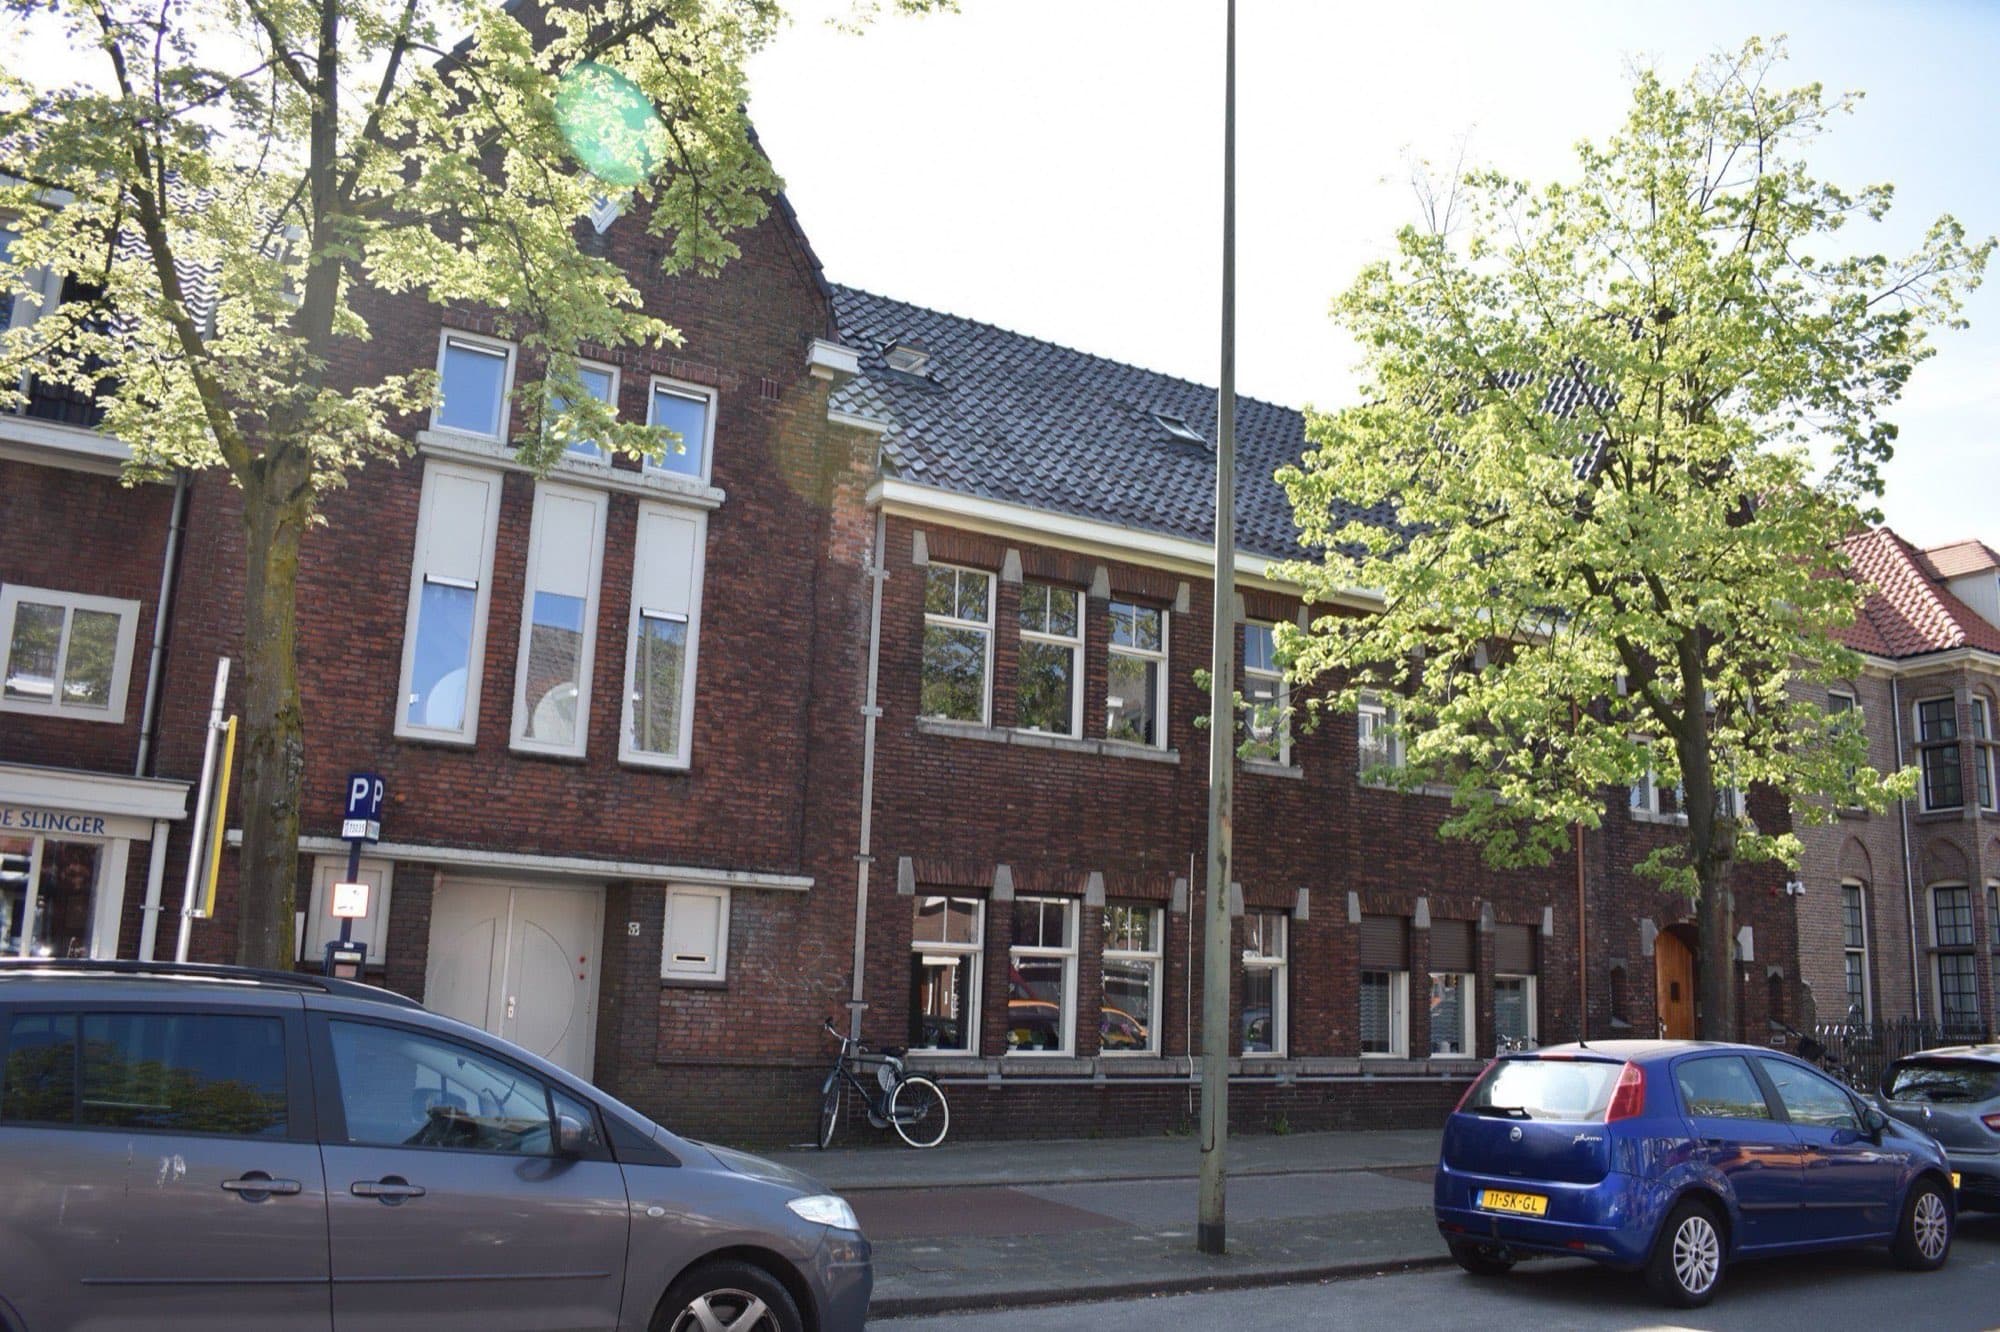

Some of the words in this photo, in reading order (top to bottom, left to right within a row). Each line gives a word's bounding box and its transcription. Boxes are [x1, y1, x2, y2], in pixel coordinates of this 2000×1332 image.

[350, 777, 369, 812] P
[371, 779, 384, 813] P
[0, 808, 13, 826] E
[20, 810, 105, 834] SLINGER
